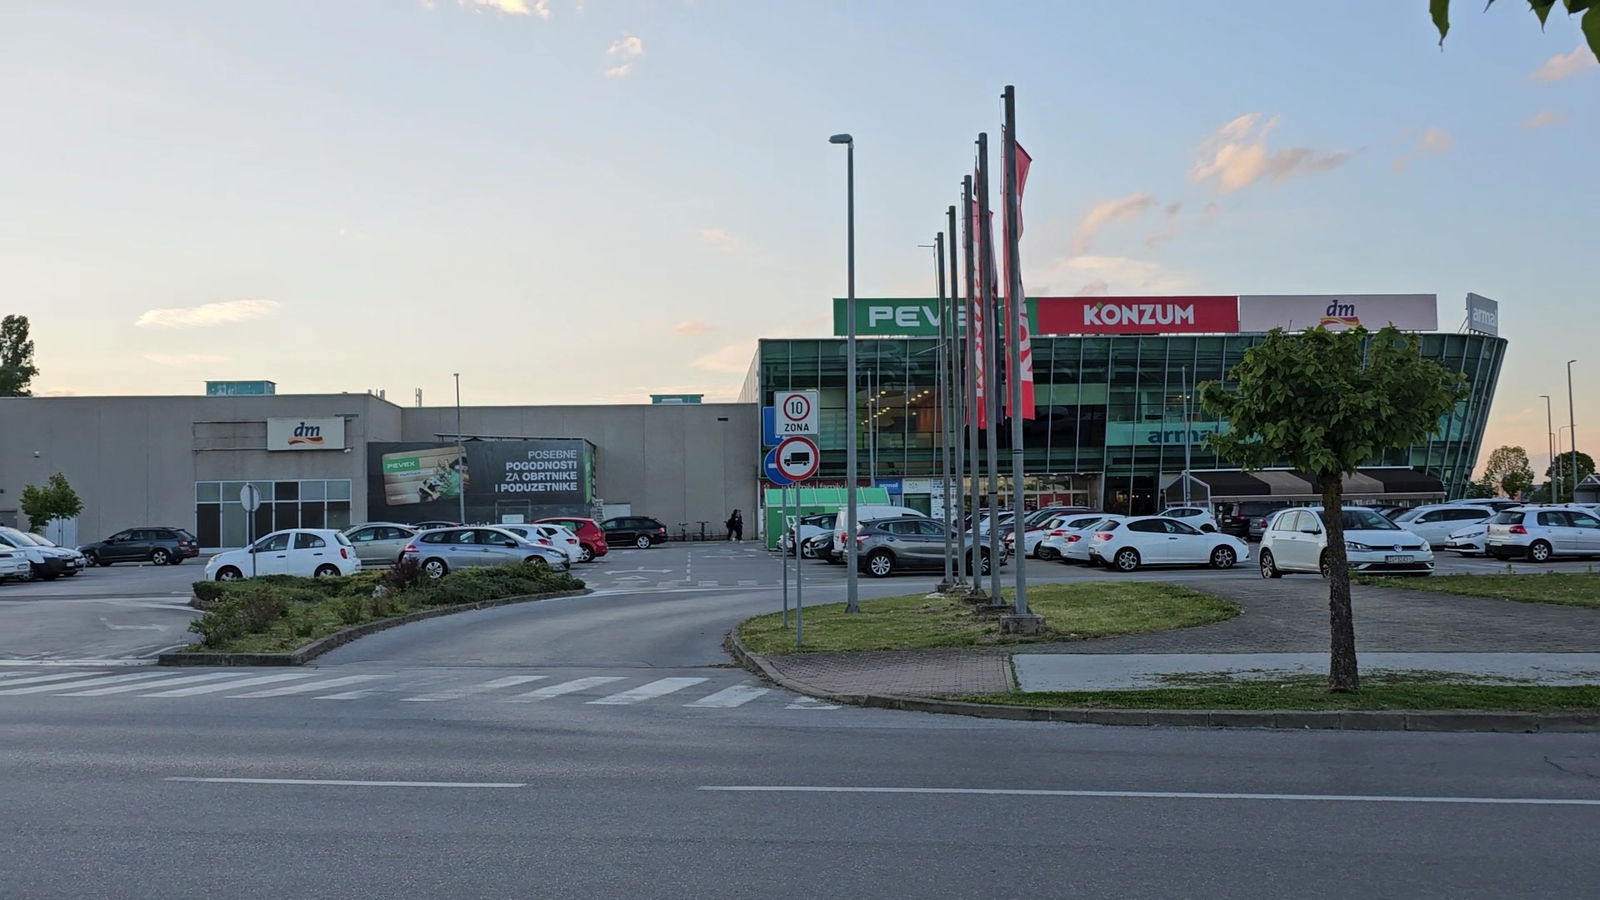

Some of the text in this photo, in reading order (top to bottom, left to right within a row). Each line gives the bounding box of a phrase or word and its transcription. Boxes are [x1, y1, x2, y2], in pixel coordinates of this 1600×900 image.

[1326, 299, 1355, 316] dm
[868, 305, 1005, 328] PEV
[1083, 303, 1194, 326] KONZUM
[790, 401, 803, 415] 10
[293, 421, 321, 437] dm
[784, 423, 810, 432] ZONA
[528, 450, 577, 460] POSEBNE
[505, 461, 578, 471] POGODNOSTI
[505, 471, 578, 482] ZA OBRTNIKE
[494, 482, 578, 493] I PODUZETNIKE
